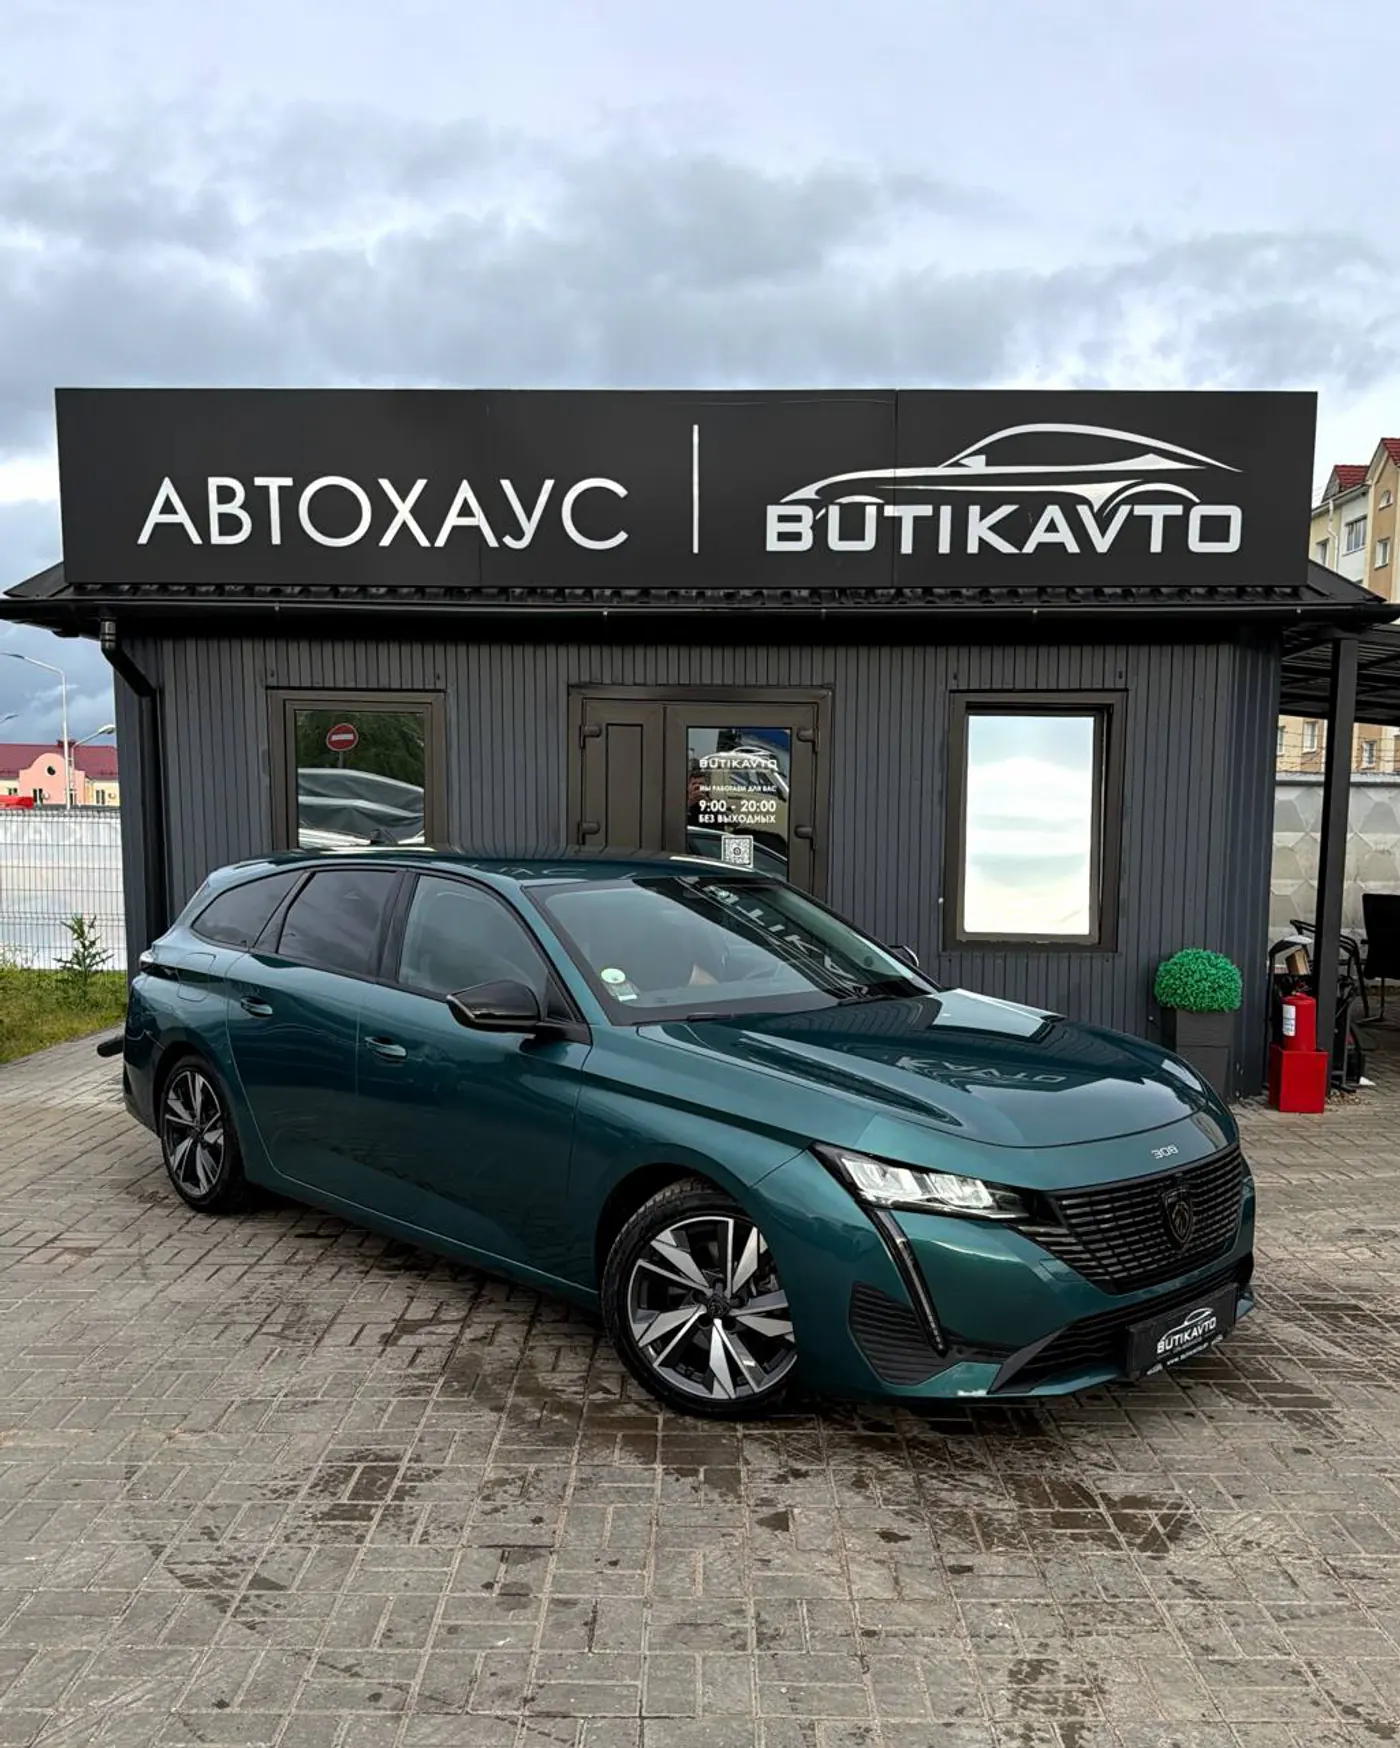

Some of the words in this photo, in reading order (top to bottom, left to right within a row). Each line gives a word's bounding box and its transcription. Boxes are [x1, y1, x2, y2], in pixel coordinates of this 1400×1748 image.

[137, 476, 629, 550] АВТОХАУС
[766, 504, 1242, 554] BUTIKAVTO
[699, 759, 778, 769] BUTIKAVTO
[699, 800, 727, 812] 9:00
[740, 800, 777, 812] 20:00
[699, 814, 714, 823] БЕЗ
[717, 814, 776, 824] ВЫХОДНЫХ
[1151, 1144, 1179, 1159] 308
[1157, 1317, 1217, 1354] BUTIKAVTO
